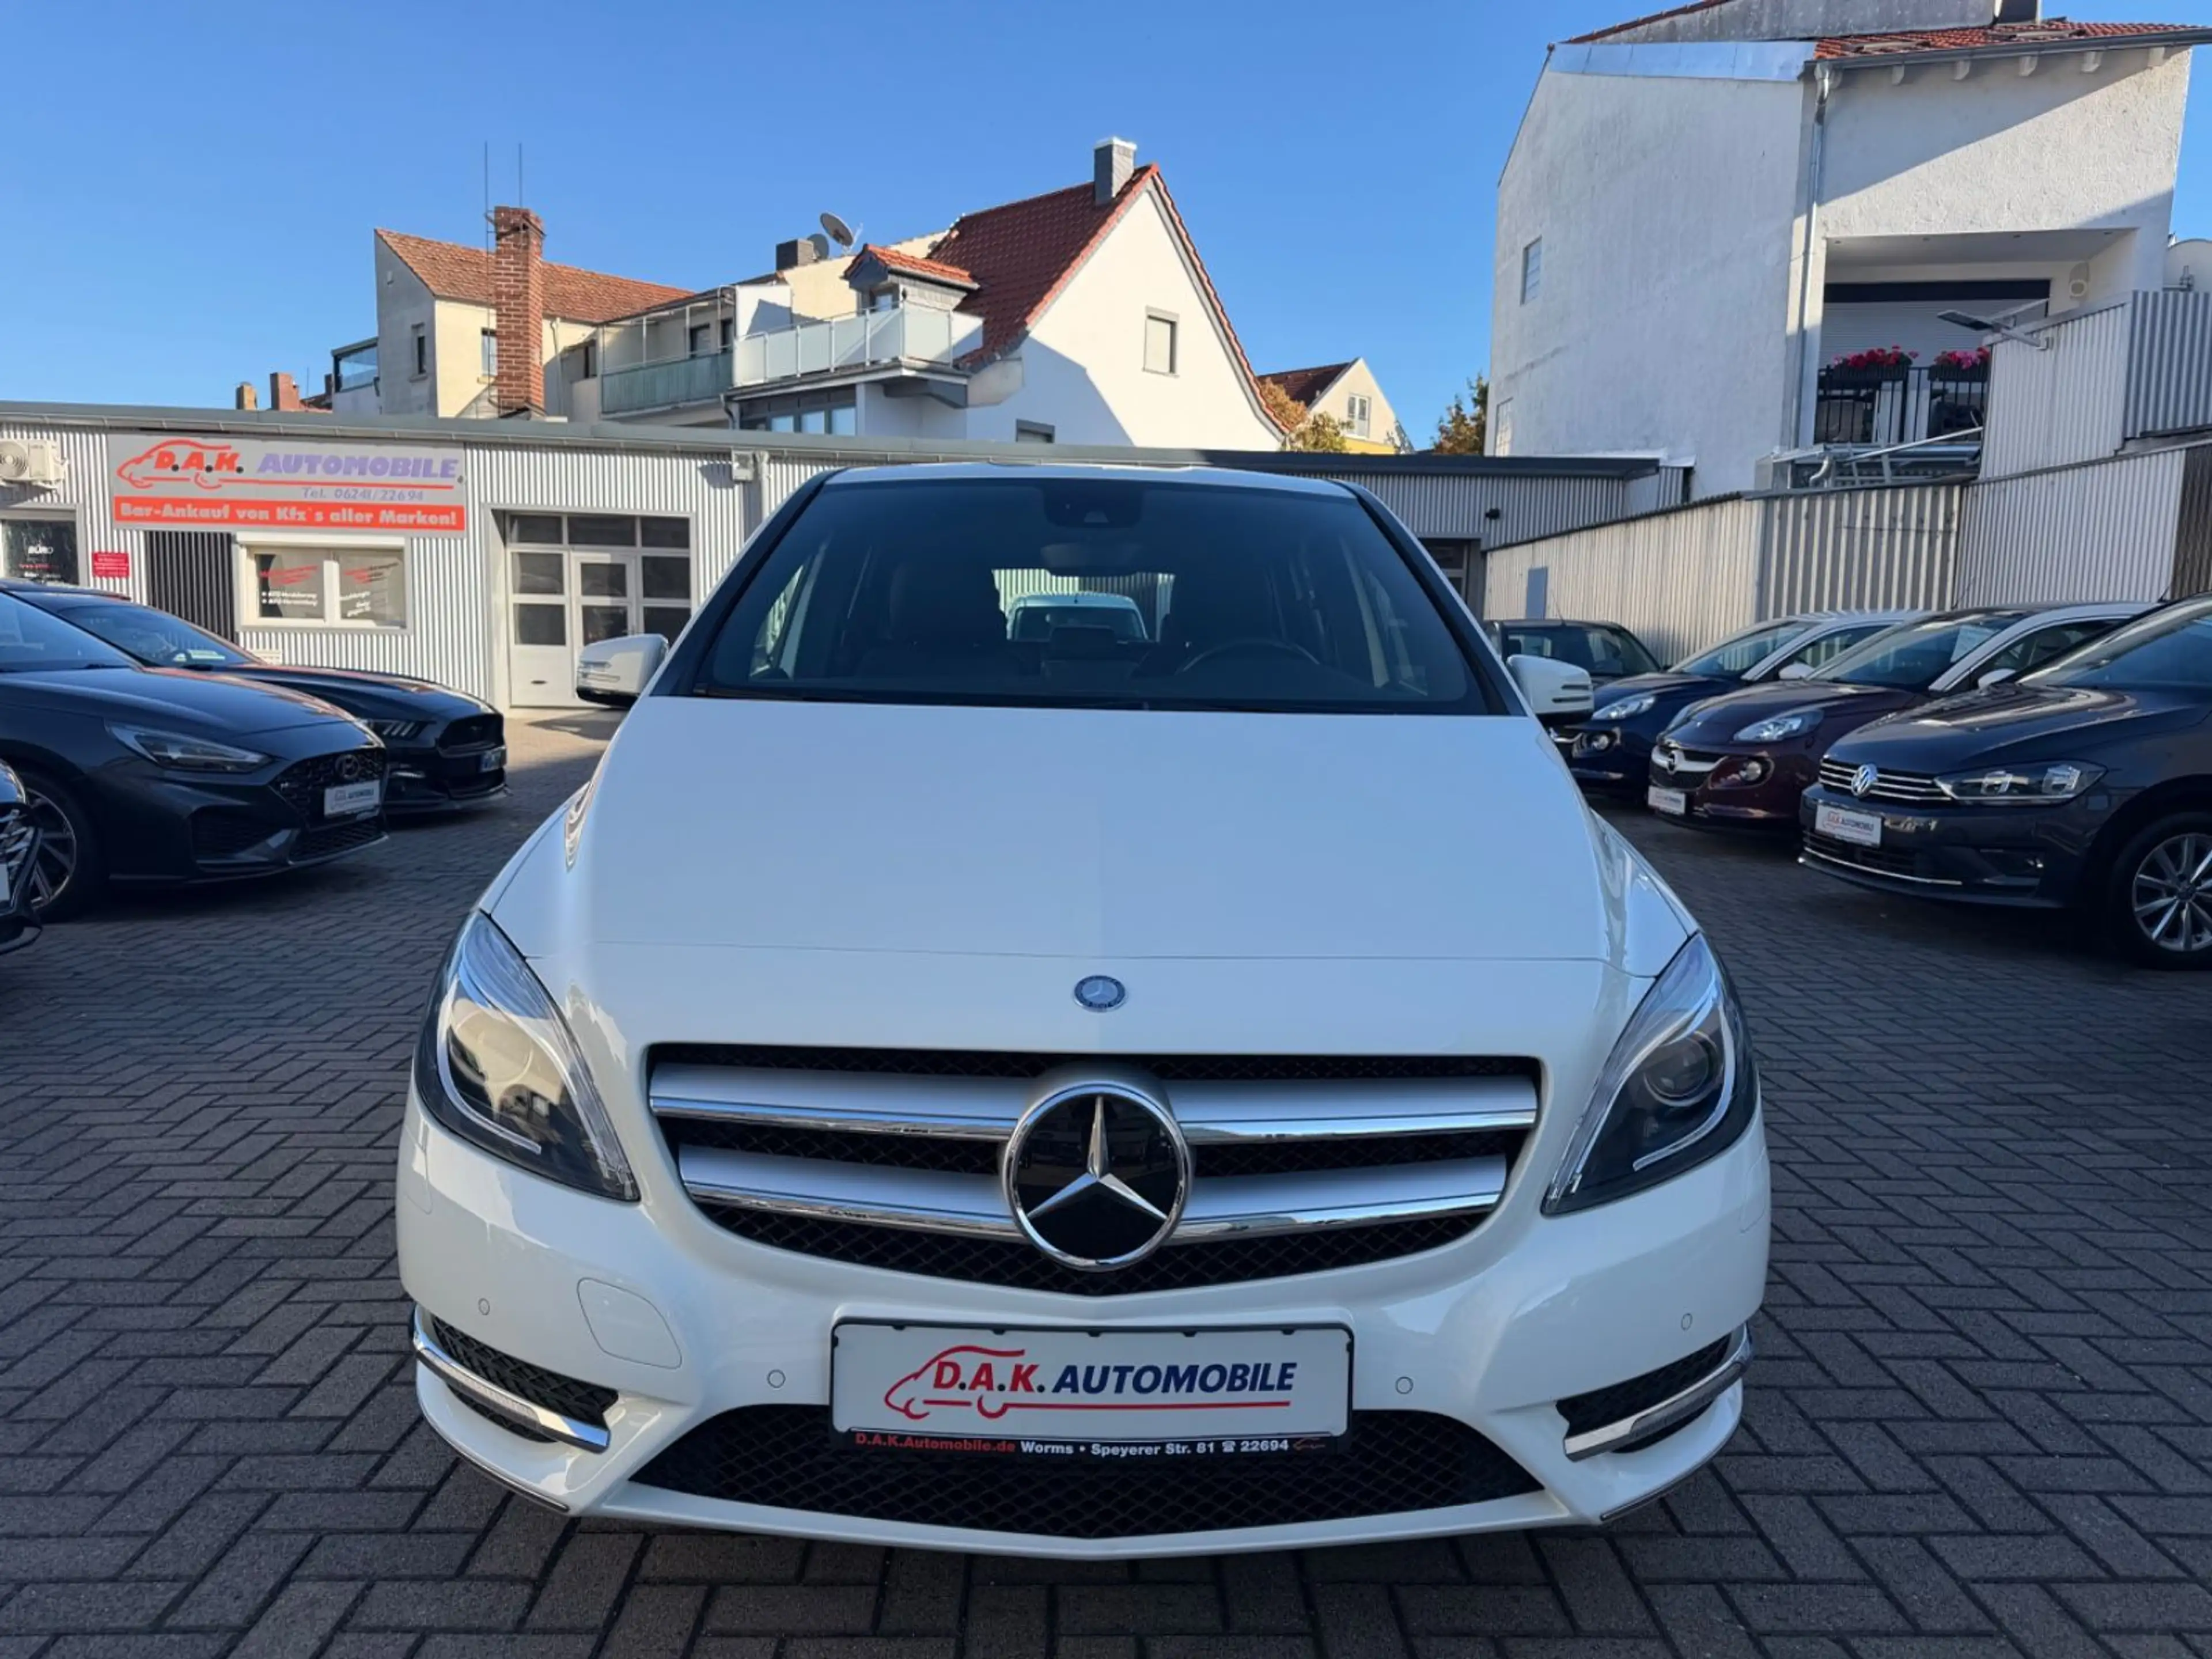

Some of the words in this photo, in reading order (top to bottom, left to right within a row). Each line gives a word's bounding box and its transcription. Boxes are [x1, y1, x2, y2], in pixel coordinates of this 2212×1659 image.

[153, 450, 244, 474] D.A.K.
[257, 453, 459, 478] AUTOMOBILE
[302, 487, 326, 498] Tel.
[120, 503, 230, 518] Bar-Ankauf
[237, 508, 270, 520] von
[330, 507, 374, 524] aller
[379, 509, 457, 525] Marken!
[933, 1361, 1046, 1393] D.A.K.
[1052, 1362, 1297, 1394] AUTOMOBILE
[855, 1432, 1016, 1452] D.A.K.Automobile.de
[1020, 1441, 1074, 1455] Worms
[1090, 1442, 1160, 1458] Speyerer
[1165, 1442, 1191, 1455] Str.
[1196, 1442, 1214, 1454] 81
[1240, 1439, 1289, 1452] 22694
